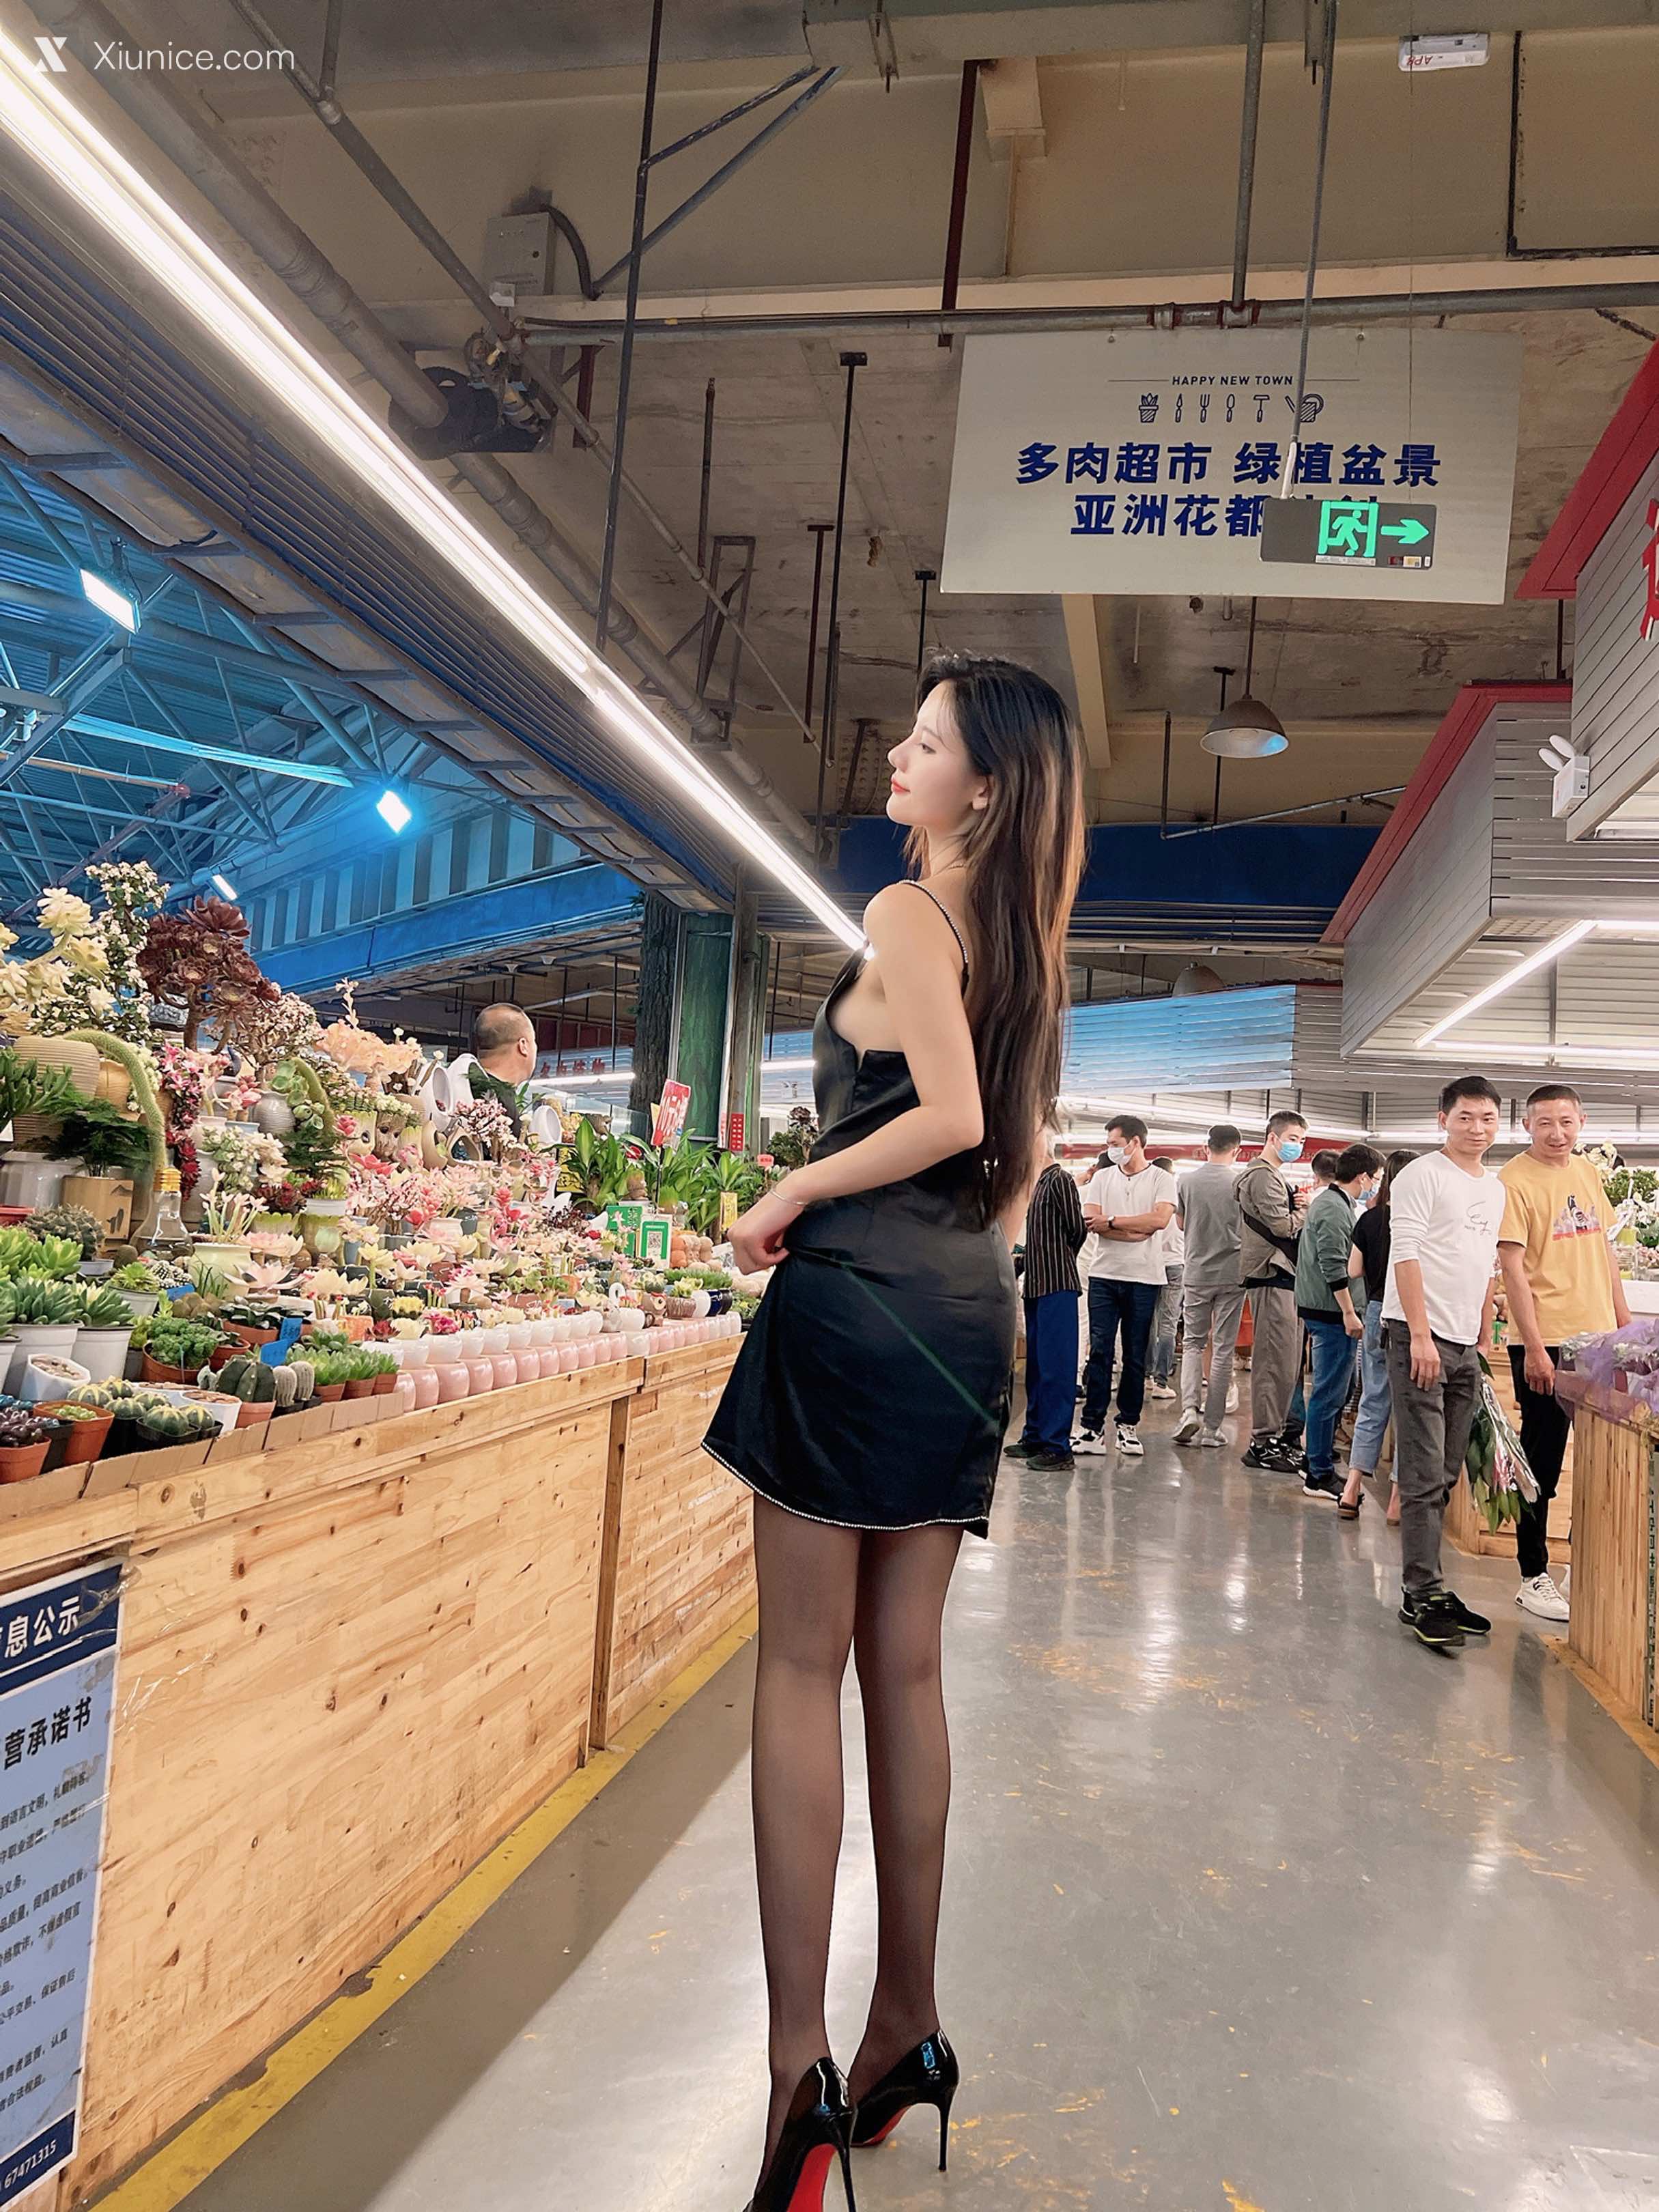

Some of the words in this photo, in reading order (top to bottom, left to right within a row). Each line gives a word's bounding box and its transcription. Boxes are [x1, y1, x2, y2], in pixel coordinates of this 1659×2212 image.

[1172, 375, 1215, 386] HAPPY
[1220, 375, 1250, 386] NEW
[1255, 375, 1293, 386] TOWN
[1015, 442, 1213, 485] 多肉超市
[1233, 442, 1442, 487] 绿植盆景
[1070, 494, 1378, 537] 亚洲花都
[0, 1596, 81, 1658] 息公示
[4, 1696, 91, 1770] 营承诺书
[4, 2139, 57, 2189] 67471315
